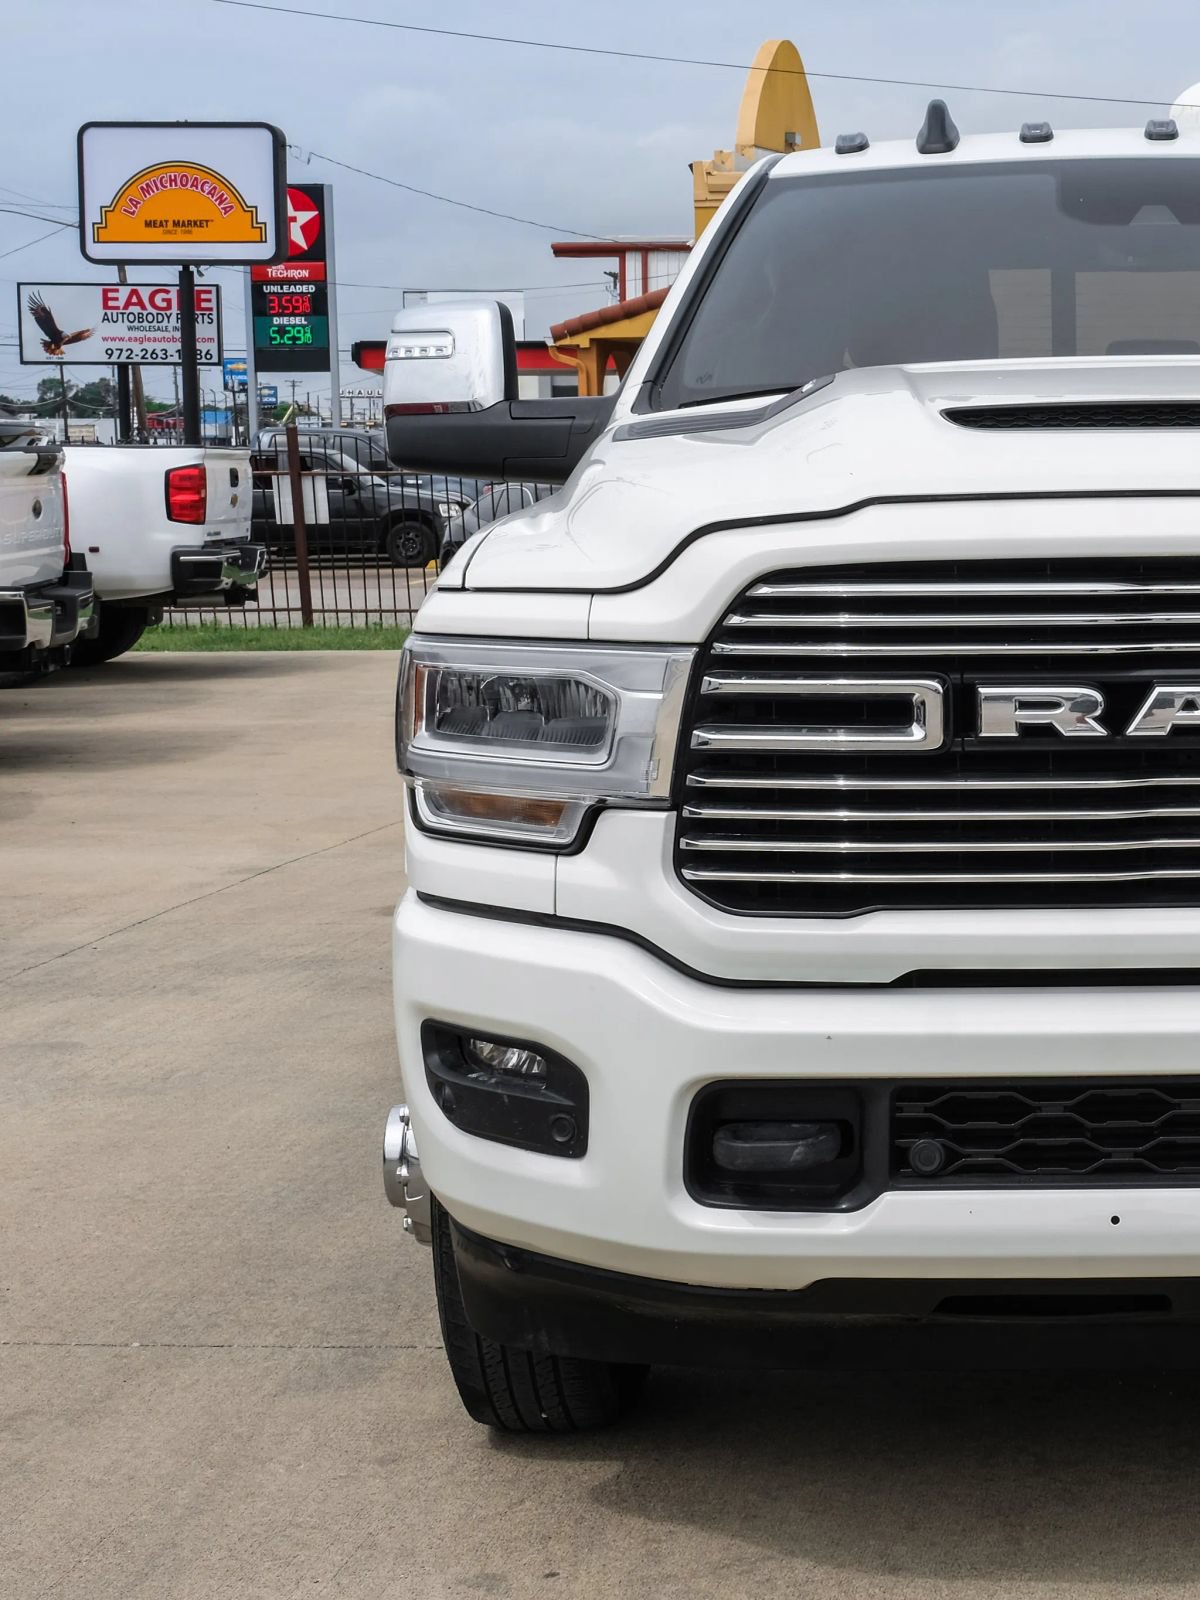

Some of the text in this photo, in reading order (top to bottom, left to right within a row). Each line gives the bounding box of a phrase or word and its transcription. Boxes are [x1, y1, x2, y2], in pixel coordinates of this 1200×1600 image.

[121, 172, 235, 218] LA MICHOACANA
[144, 219, 210, 228] MEAT MARKET
[263, 285, 316, 293] UNLEADED
[102, 287, 214, 312] EAGE
[101, 311, 214, 324] AUTOBODY PRTS
[273, 317, 307, 325] DIESEL
[127, 325, 170, 333] WHOLESALE,
